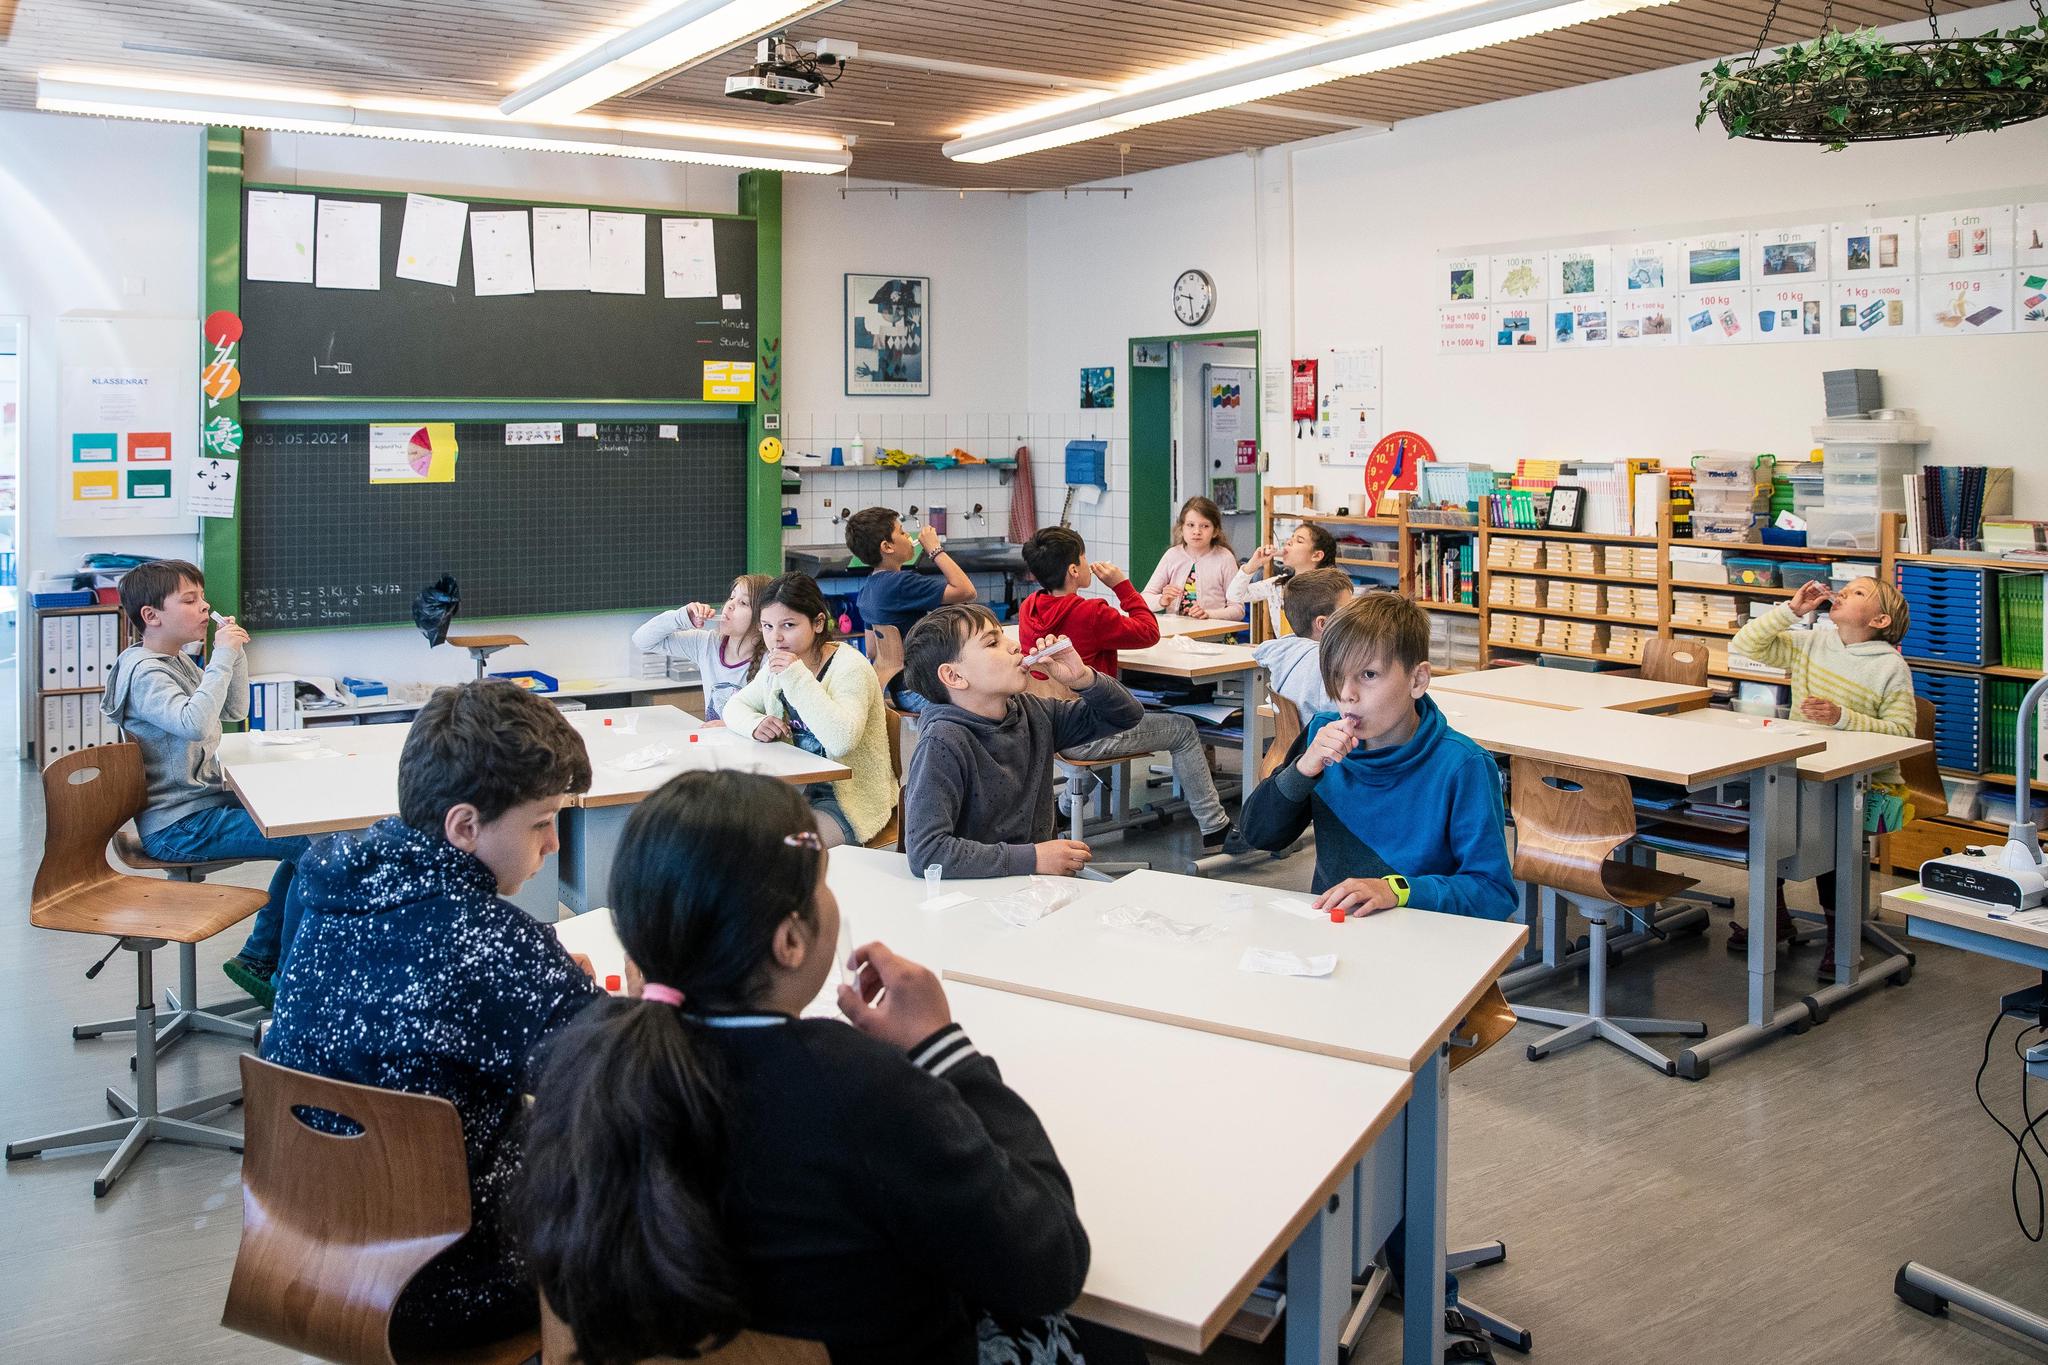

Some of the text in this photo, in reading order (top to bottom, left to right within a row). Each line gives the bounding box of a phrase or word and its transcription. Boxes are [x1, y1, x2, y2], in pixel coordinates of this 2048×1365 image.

[1952, 215, 1980, 226] 1 dm
[1864, 225, 1882, 234] 1 m
[1778, 233, 1789, 242] 10
[1701, 240, 1728, 249] 100 m
[1642, 248, 1655, 256] km
[1507, 258, 1519, 266] 100
[1949, 281, 1981, 292] 100 g
[1777, 291, 1803, 302] 10 kg
[1846, 287, 1851, 296] 1
[1855, 287, 1868, 298] kg
[1878, 287, 1900, 296] 1000g
[1701, 295, 1730, 306] 100 kg
[1511, 310, 1523, 318] 100
[1573, 305, 1582, 313] 10
[1447, 314, 1455, 322] kg
[1463, 312, 1480, 320] 1000
[1481, 313, 1486, 321] g
[721, 318, 750, 329] Minute
[720, 337, 750, 348] Stunde
[1457, 338, 1474, 347] 1000
[1475, 338, 1485, 348] kg
[91, 377, 150, 386] KLASSENRAT
[255, 432, 349, 446] 03.05.2021
[1385, 443, 1395, 453] 11
[1412, 443, 1418, 453] 1
[1376, 453, 1386, 464] 10
[1370, 466, 1377, 477] 9
[1372, 481, 1379, 492] 8
[371, 584, 401, 597] 76/77
[1957, 881, 1985, 891] ELMO
